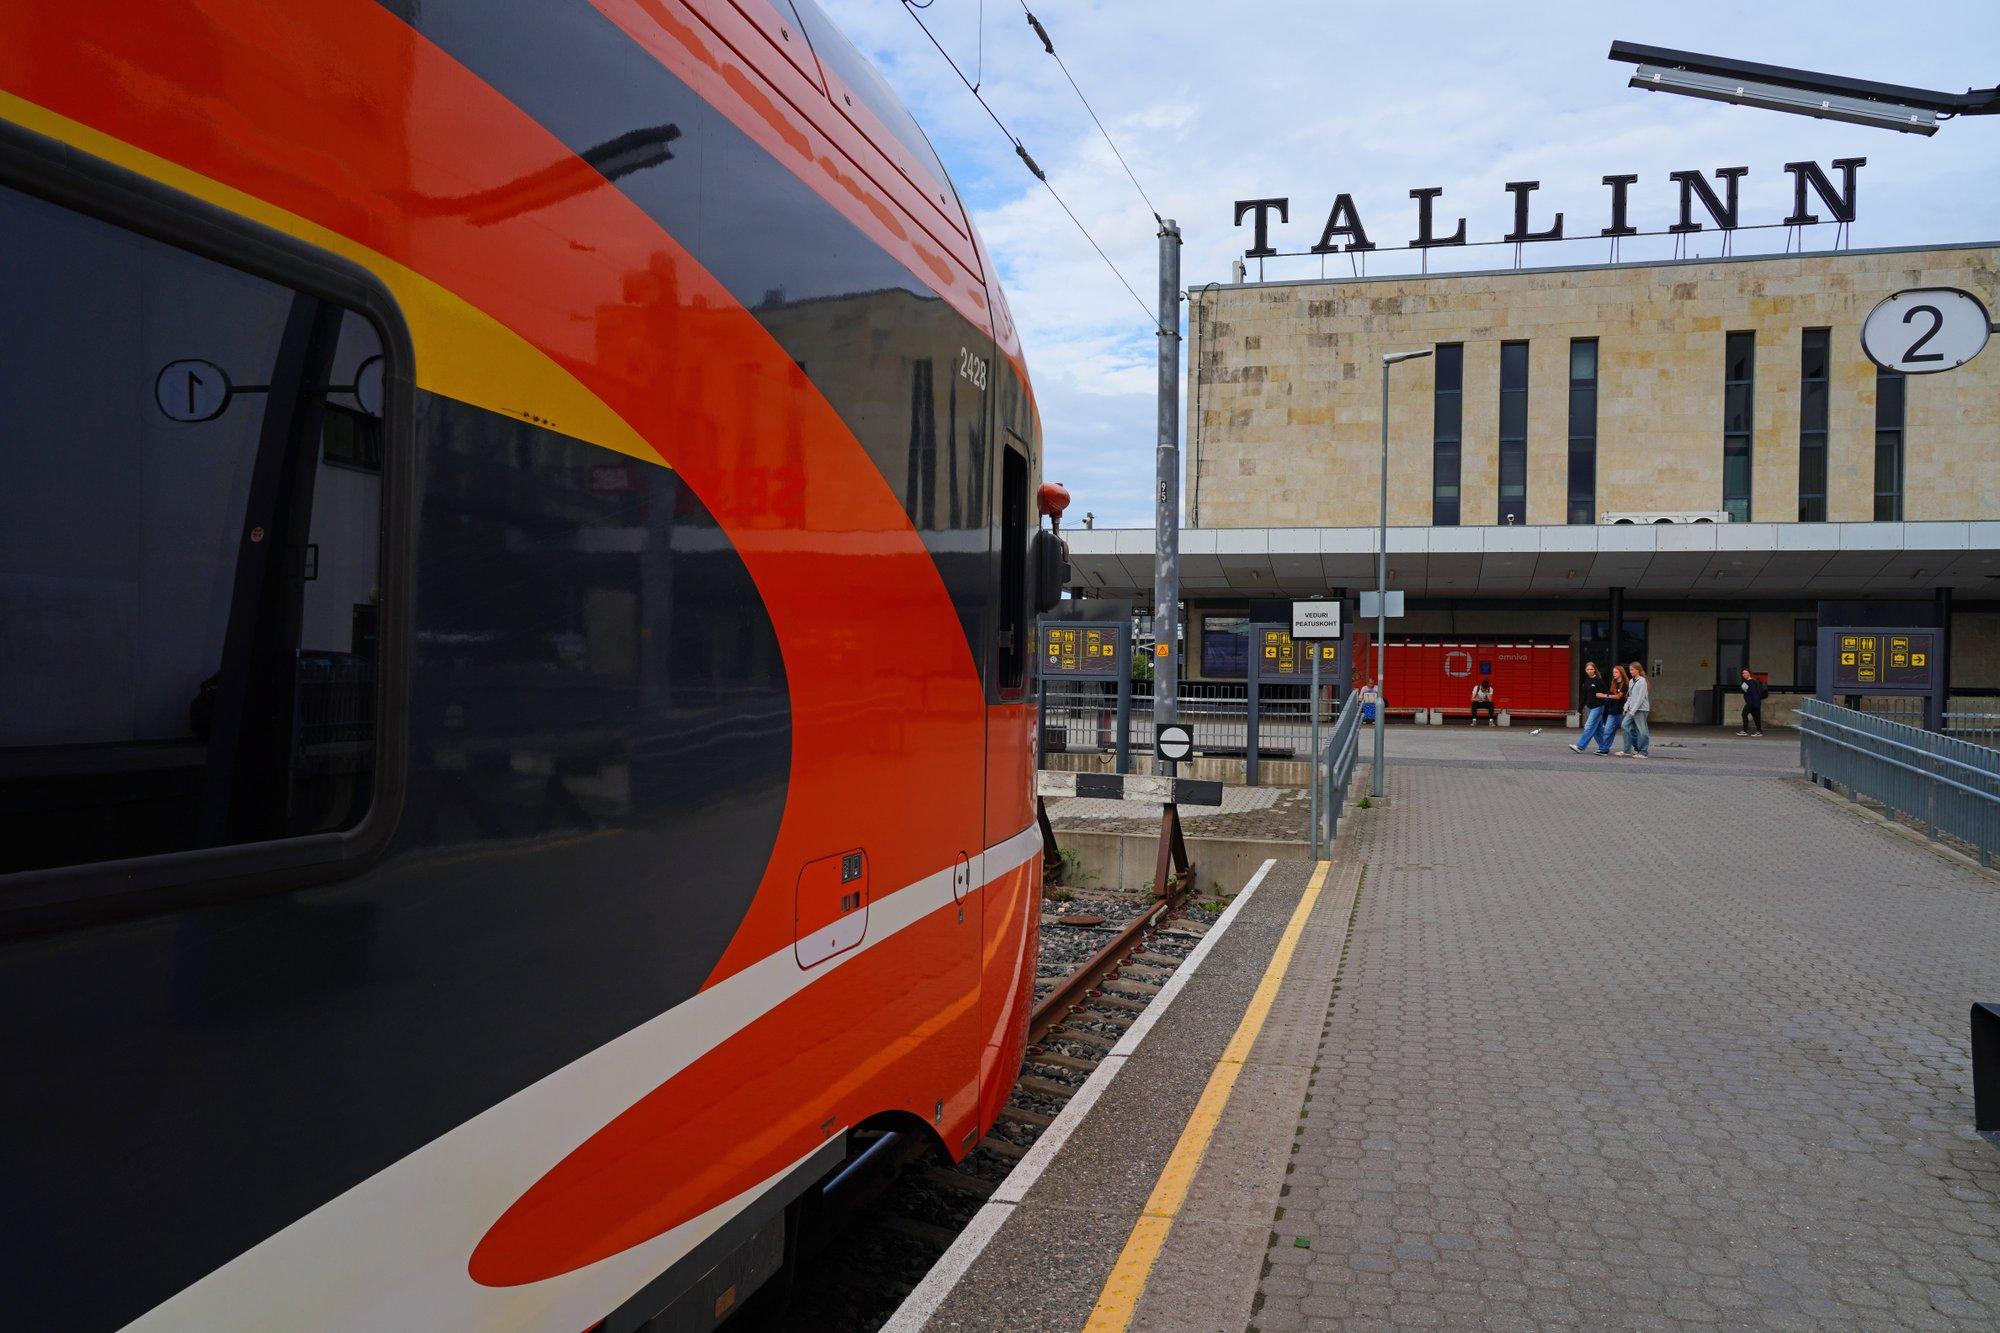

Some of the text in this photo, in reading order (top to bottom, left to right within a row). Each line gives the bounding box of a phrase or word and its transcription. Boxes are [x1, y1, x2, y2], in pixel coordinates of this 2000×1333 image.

[1234, 156, 1867, 258] TALLINN
[1902, 304, 1944, 363] 2
[960, 346, 987, 391] 2428
[1498, 653, 1528, 661] omniva
